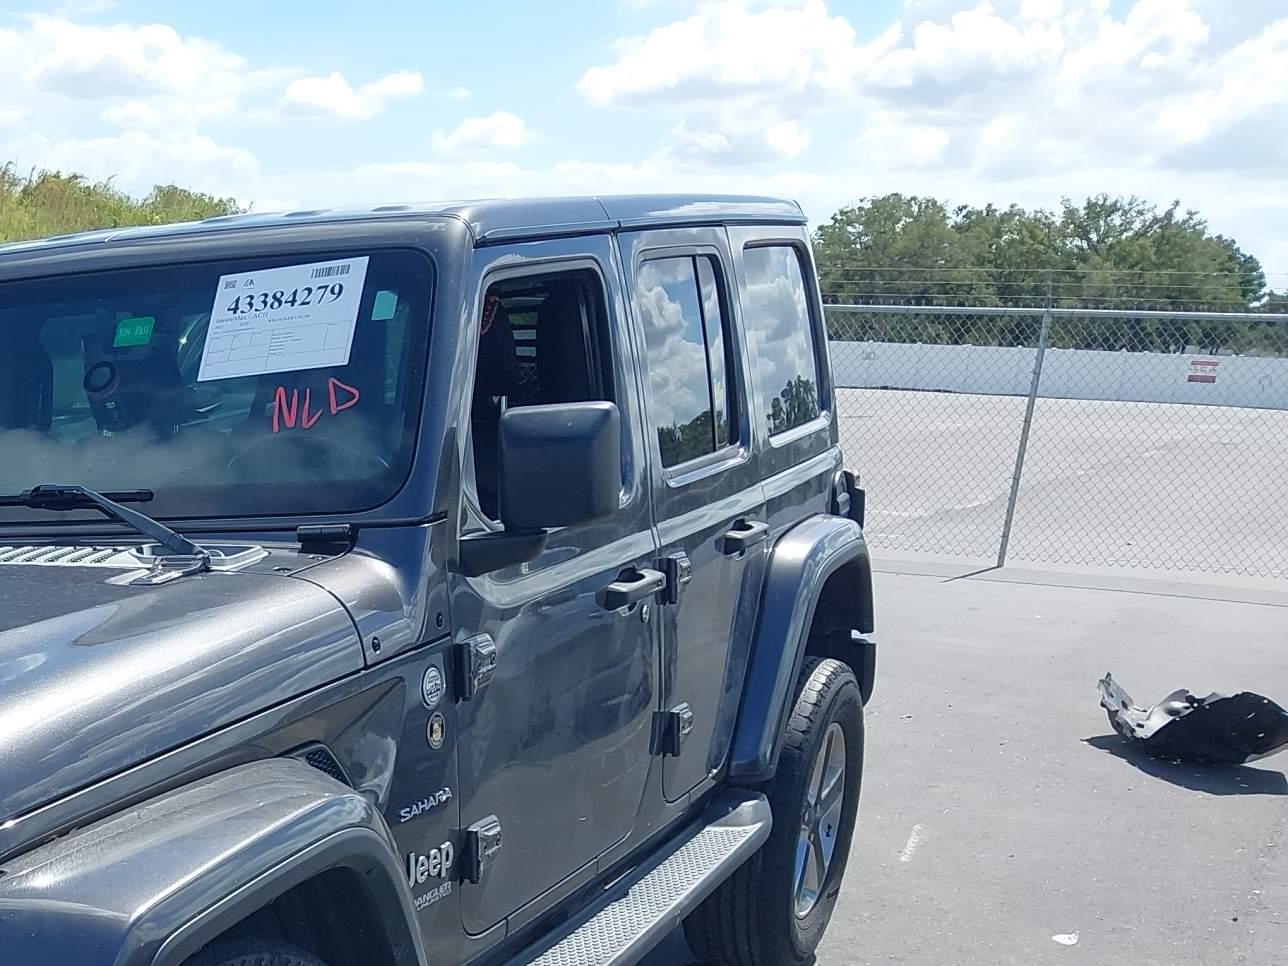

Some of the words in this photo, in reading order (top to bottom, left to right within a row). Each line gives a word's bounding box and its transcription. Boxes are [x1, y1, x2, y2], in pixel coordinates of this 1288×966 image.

[227, 283, 344, 316] 43384279
[272, 377, 360, 433] NLD
[400, 787, 453, 823] SAHARA
[409, 841, 454, 889] Jeep
